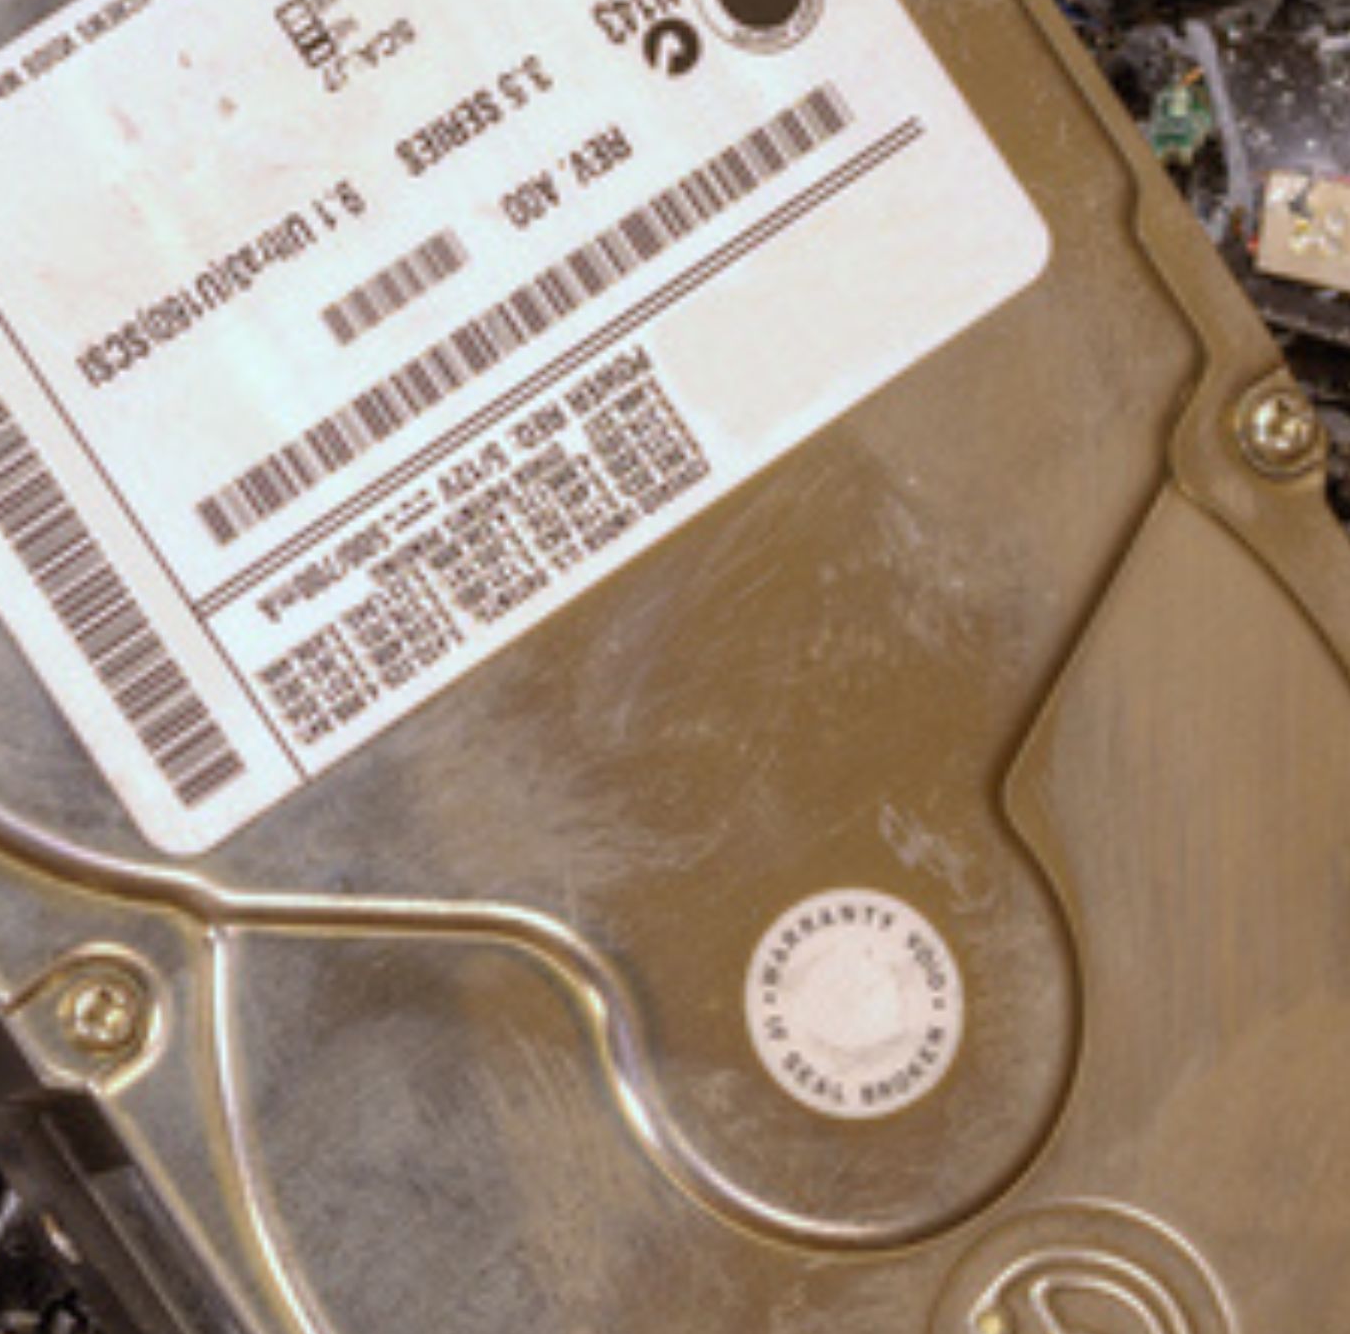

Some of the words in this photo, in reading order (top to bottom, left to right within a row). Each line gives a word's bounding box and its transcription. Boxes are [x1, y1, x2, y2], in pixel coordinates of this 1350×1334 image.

[496, 54, 553, 109] 3.5
[394, 88, 503, 177] SERIES
[559, 125, 632, 185] REV.
[562, 344, 652, 409] POWER
[761, 904, 893, 987] WARRANTY
[907, 932, 946, 991] VOID
[783, 1051, 842, 1103] SEAL
[860, 1028, 945, 1105] BROKEN
